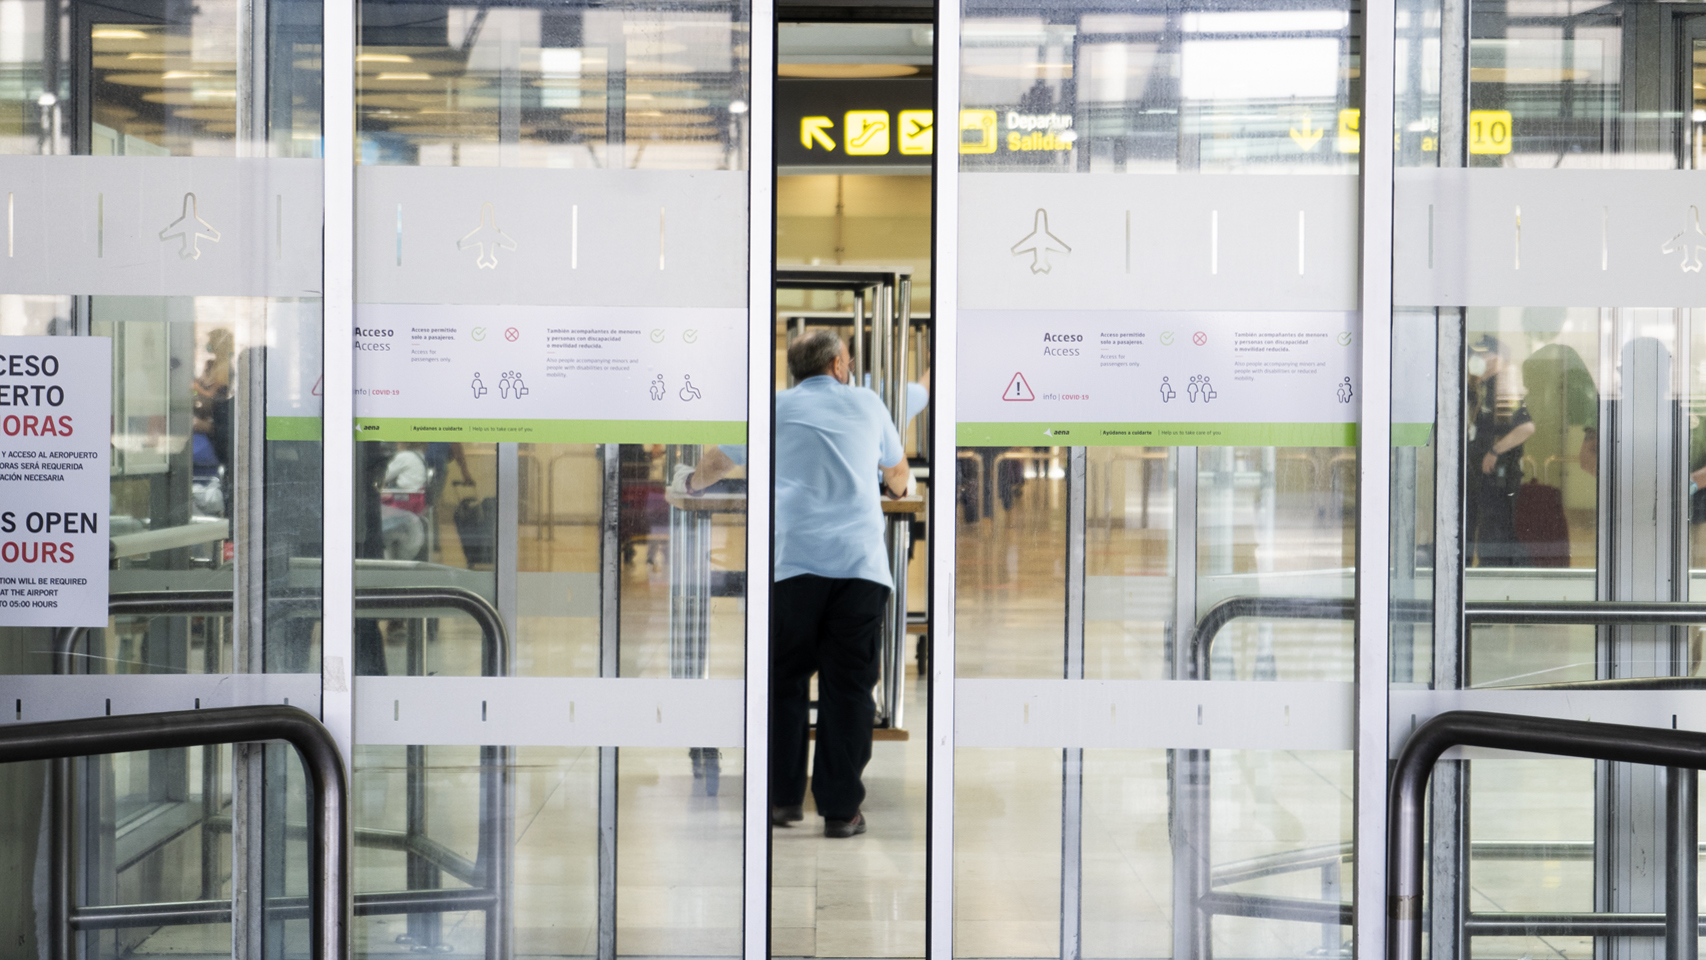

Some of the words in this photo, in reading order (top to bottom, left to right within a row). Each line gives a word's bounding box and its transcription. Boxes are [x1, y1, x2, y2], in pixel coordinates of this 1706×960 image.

[1006, 111, 1073, 131] Departur
[1473, 121, 1507, 145] 10
[354, 327, 394, 337] Acceso
[1044, 332, 1083, 343] Acceso
[355, 340, 391, 351] Access
[1044, 346, 1080, 357] Access
[0, 415, 74, 437] ORAS
[49, 451, 98, 459] AEROPUERTO
[21, 461, 40, 470] SERÁ
[42, 462, 83, 470] REQUERIDA
[24, 474, 64, 482] NECESARIA
[26, 511, 97, 534] OPEN
[2, 541, 74, 564] OURS
[50, 578, 87, 586] REQUIRED
[27, 589, 58, 597] AIRPORT
[10, 600, 30, 608] 05:00
